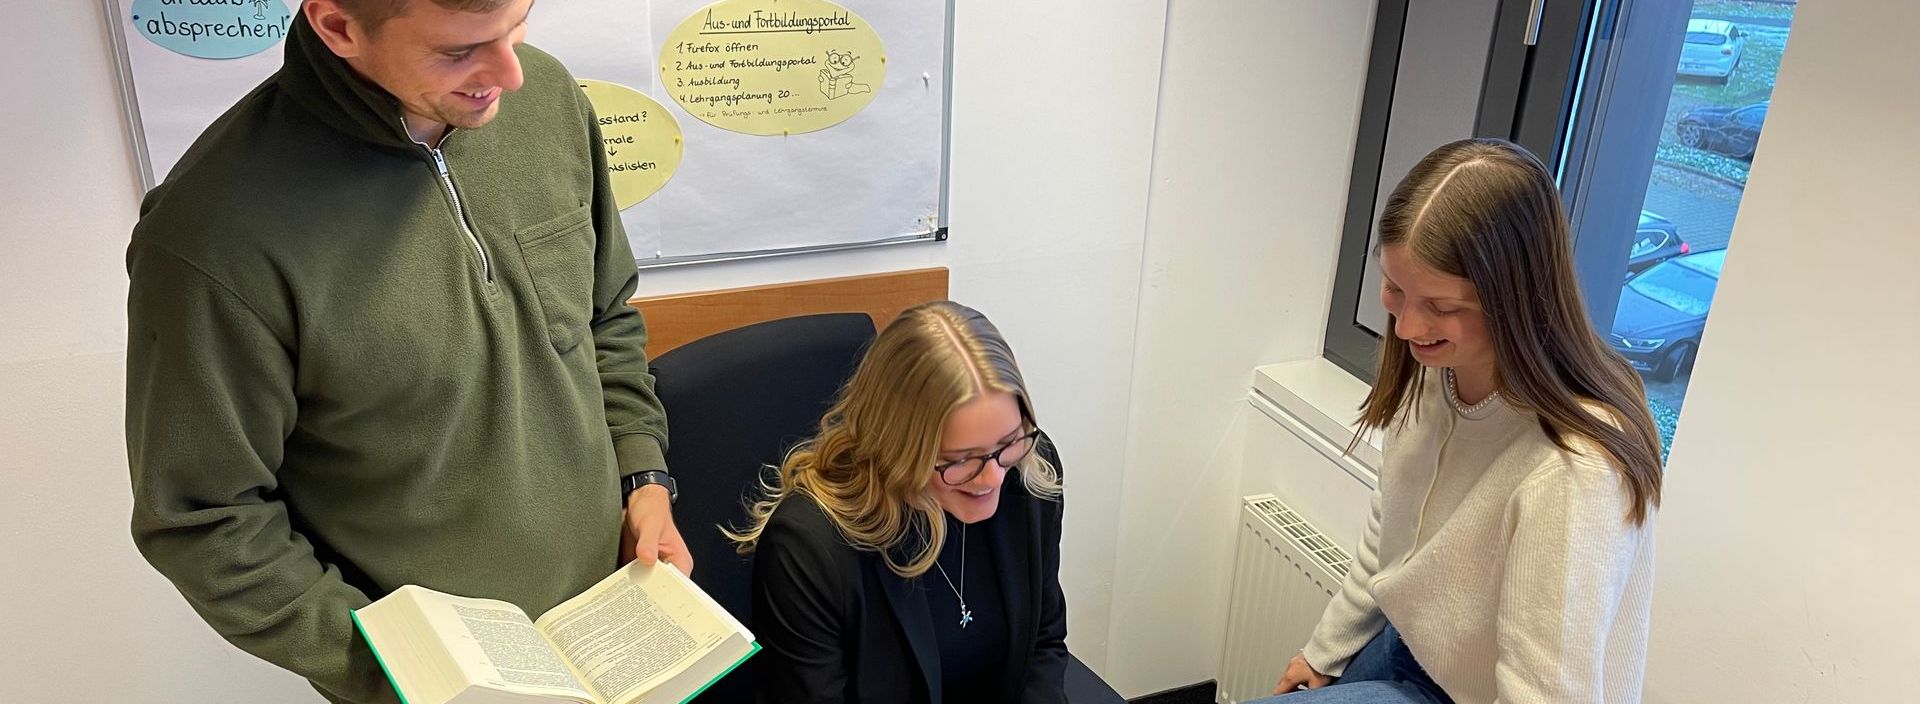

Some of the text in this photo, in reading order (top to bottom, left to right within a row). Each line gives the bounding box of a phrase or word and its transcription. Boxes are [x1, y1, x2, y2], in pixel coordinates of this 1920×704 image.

[147, 11, 286, 42] absprechen!
[754, 10, 850, 34] Fortbildungsportal
[686, 42, 720, 54] Firefox
[725, 42, 758, 53] öffnen
[729, 56, 817, 72] Fortbildungsportal
[688, 76, 740, 90] Ausbildung
[679, 94, 688, 103] 4.
[690, 91, 773, 107] Lehrgangsplanung
